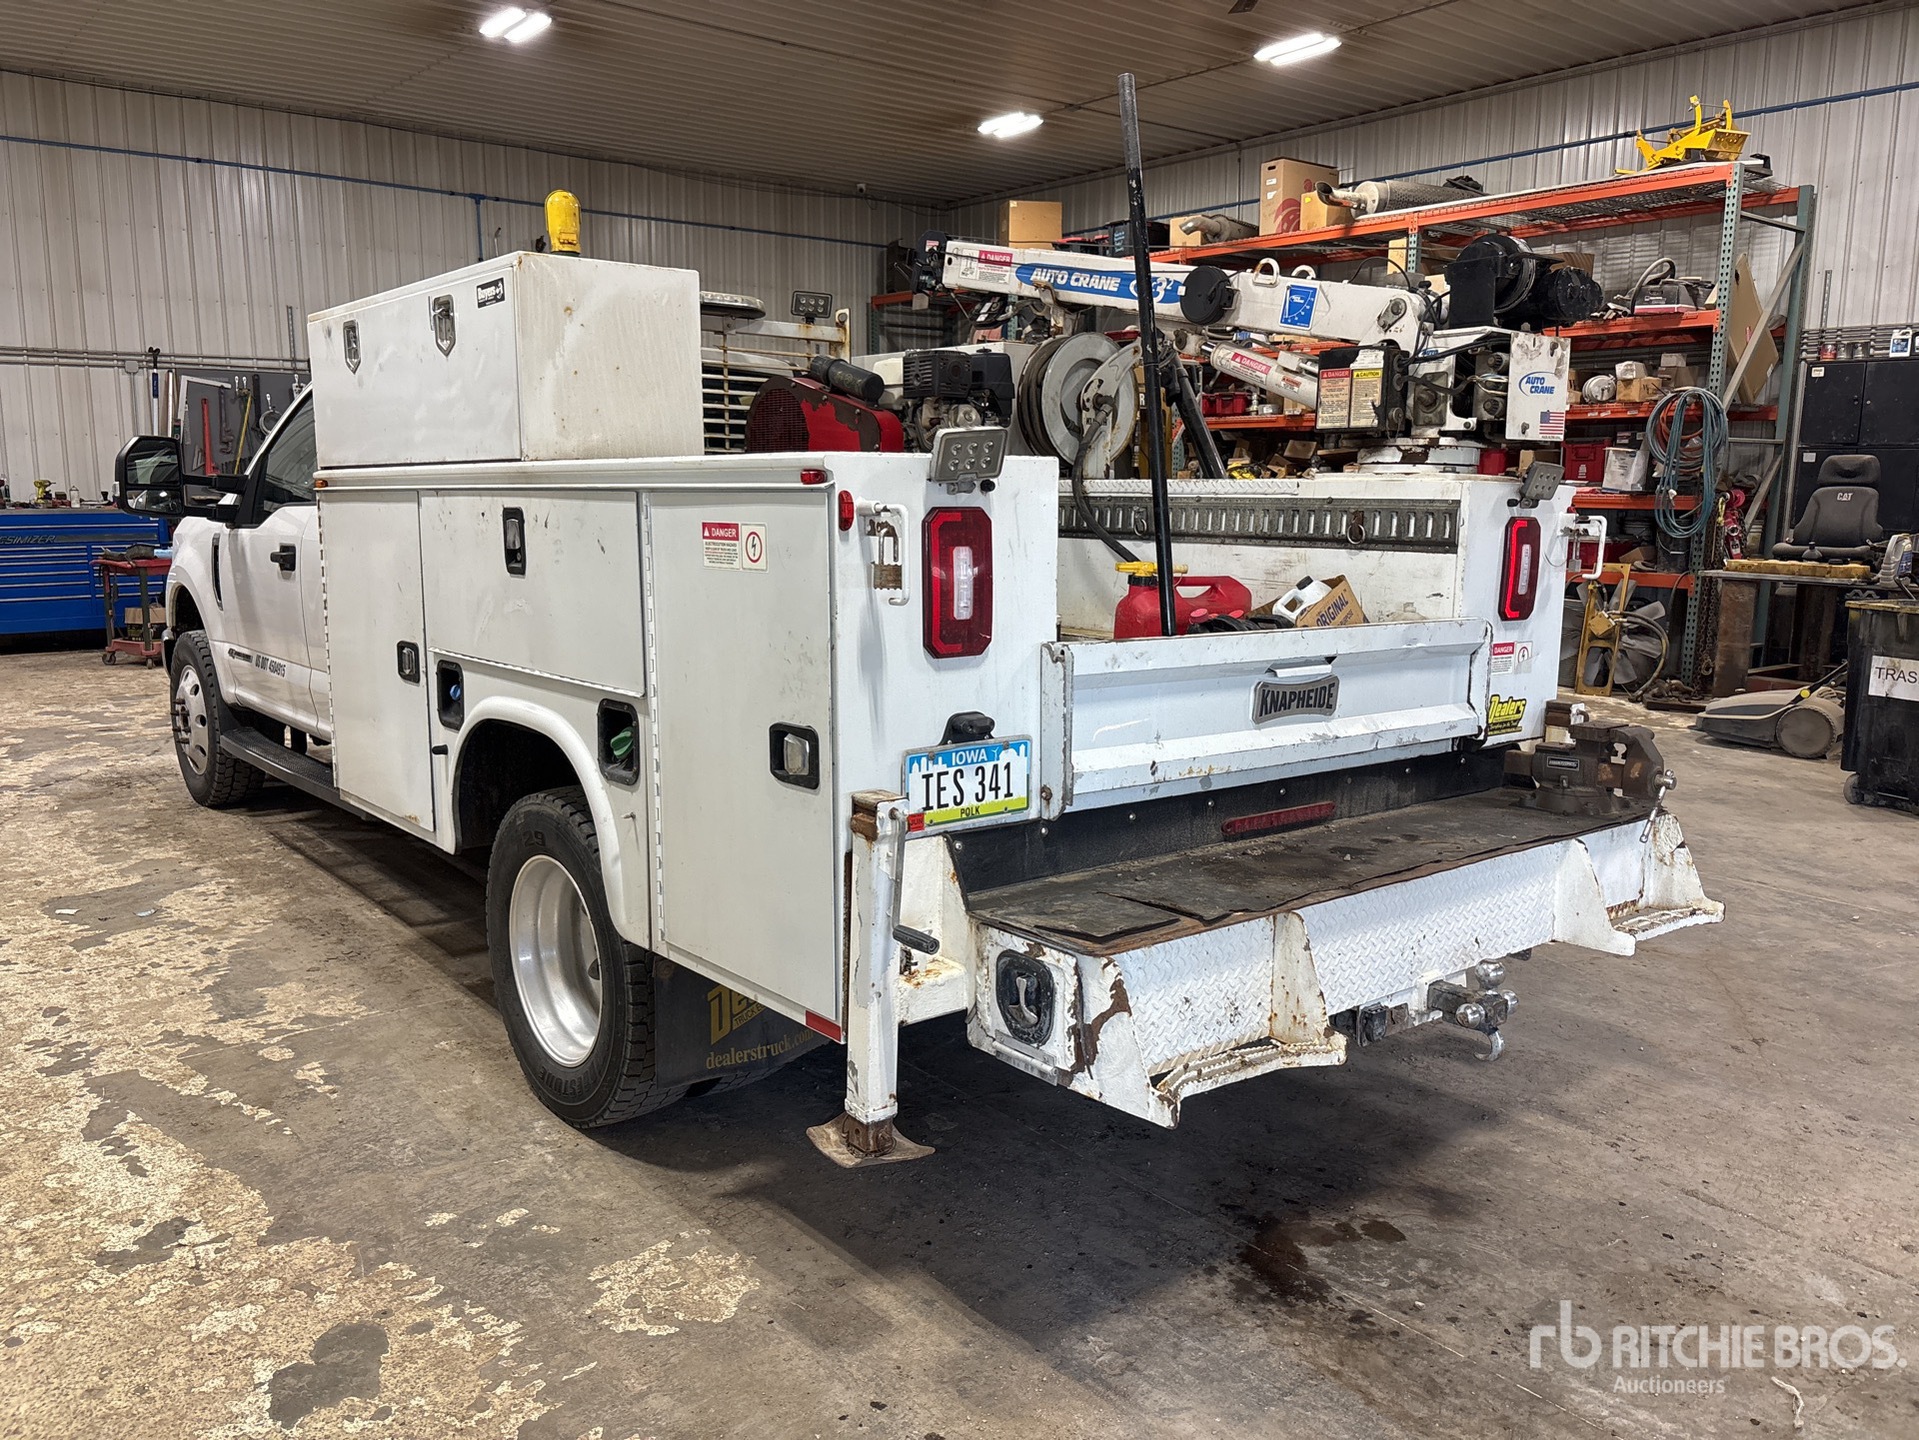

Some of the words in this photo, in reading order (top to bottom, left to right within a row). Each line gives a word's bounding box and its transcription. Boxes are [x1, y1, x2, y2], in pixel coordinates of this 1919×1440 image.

[986, 253, 1011, 263] DANGER
[1030, 267, 1069, 285] AUTO
[1070, 272, 1121, 292] CRANE
[1241, 357, 1267, 373] DANGER
[1525, 377, 1545, 385] AUTO
[1530, 386, 1555, 394] CRANE
[1836, 492, 1853, 501] CAT
[711, 527, 737, 538] DANGER
[1316, 592, 1349, 627] ORIGINAL
[1494, 646, 1513, 654] DANGER
[1259, 682, 1336, 717] KNAPHEIDE
[1488, 695, 1525, 723] Dealers
[951, 748, 988, 766] IOWA
[974, 762, 1014, 803] 341
[960, 806, 981, 818] POLK
[706, 1028, 815, 1070] dealerstruck.com
